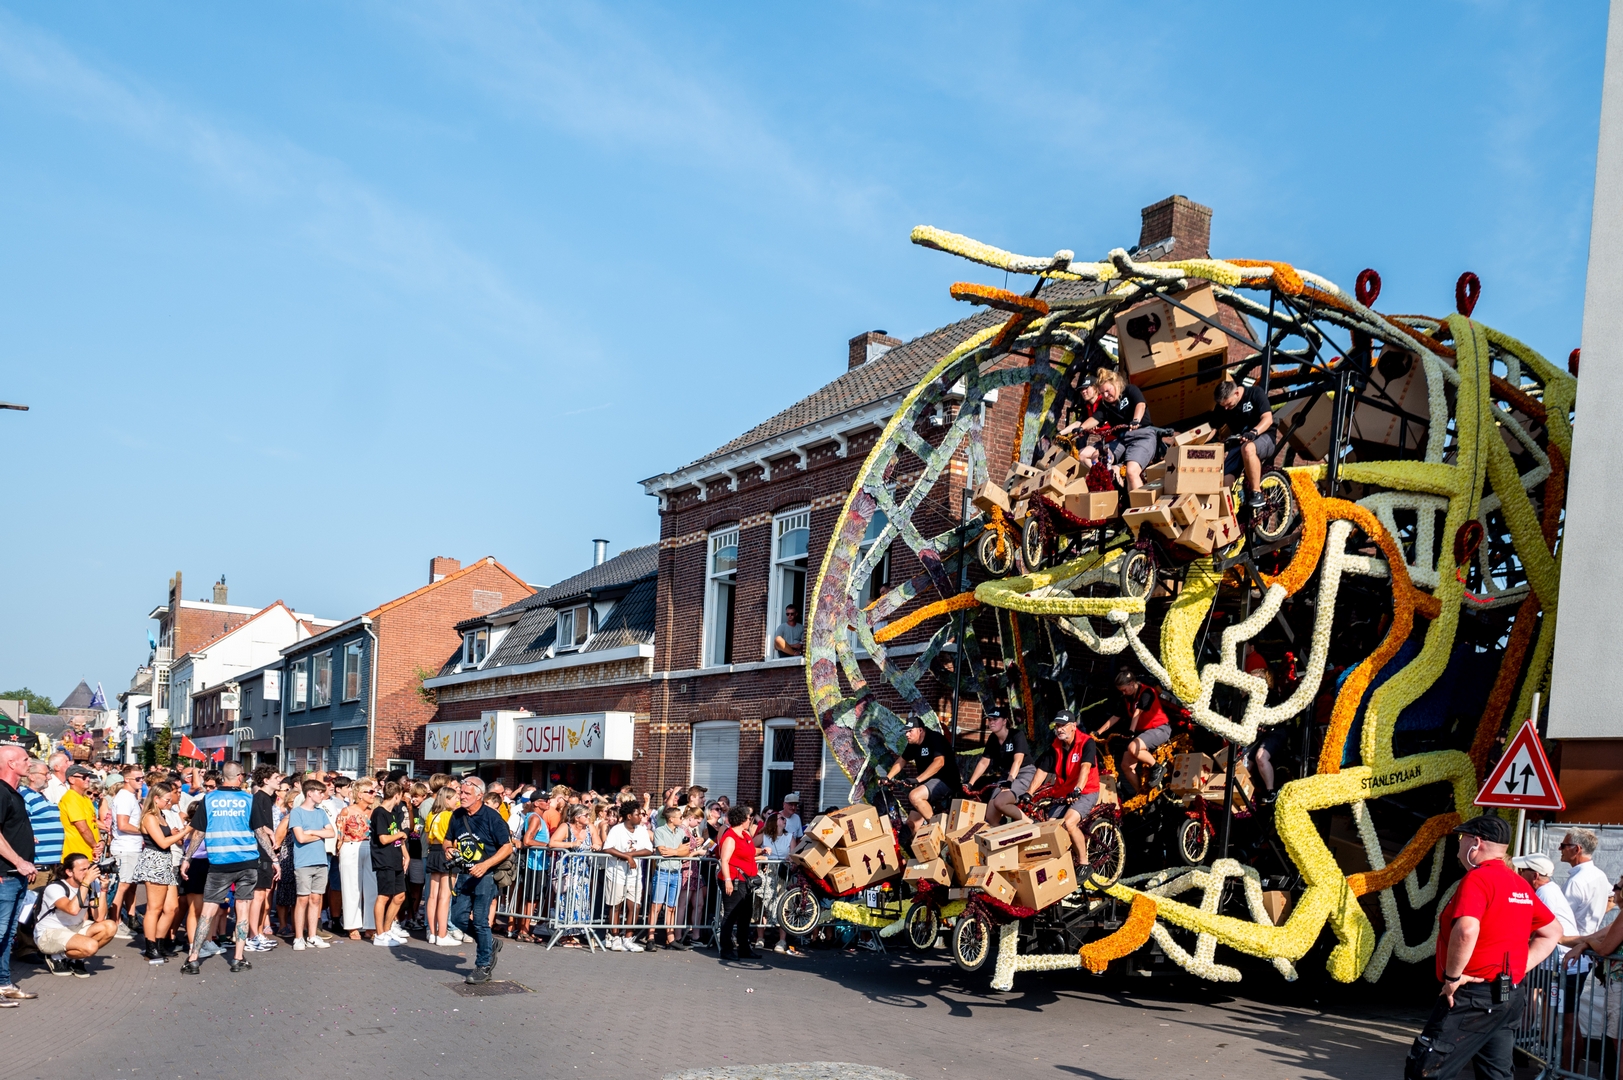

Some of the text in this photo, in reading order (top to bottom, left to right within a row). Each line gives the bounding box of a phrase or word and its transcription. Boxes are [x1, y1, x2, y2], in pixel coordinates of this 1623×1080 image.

[453, 730, 481, 753] LUCK
[525, 726, 565, 753] SUSHI
[1361, 765, 1421, 789] STANLEYLAAN
[211, 799, 246, 808] corso
[212, 808, 246, 817] zundert
[868, 893, 876, 902] 19
